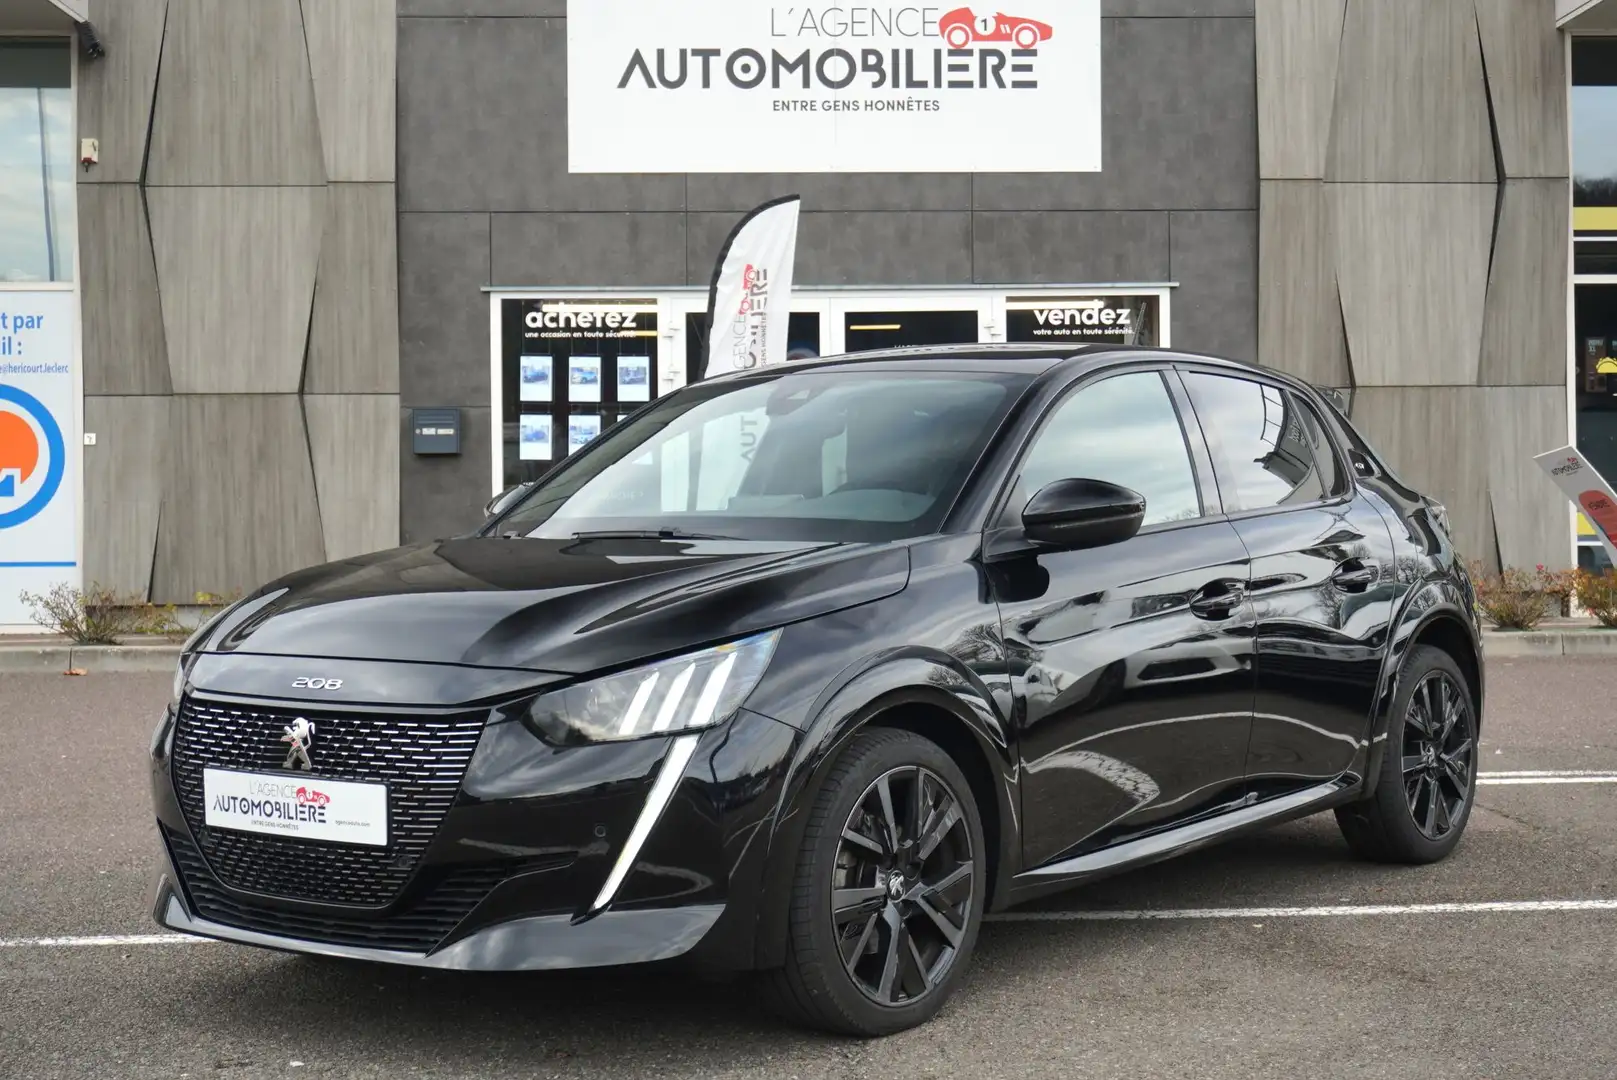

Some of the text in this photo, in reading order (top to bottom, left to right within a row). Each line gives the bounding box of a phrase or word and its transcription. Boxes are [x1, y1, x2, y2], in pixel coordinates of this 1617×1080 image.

[772, 96, 940, 112] ENTRE GENS HONNÊTES
[525, 302, 637, 328] achetez
[1033, 299, 1131, 326] vendez
[13, 315, 44, 335] par
[292, 676, 344, 690] 208
